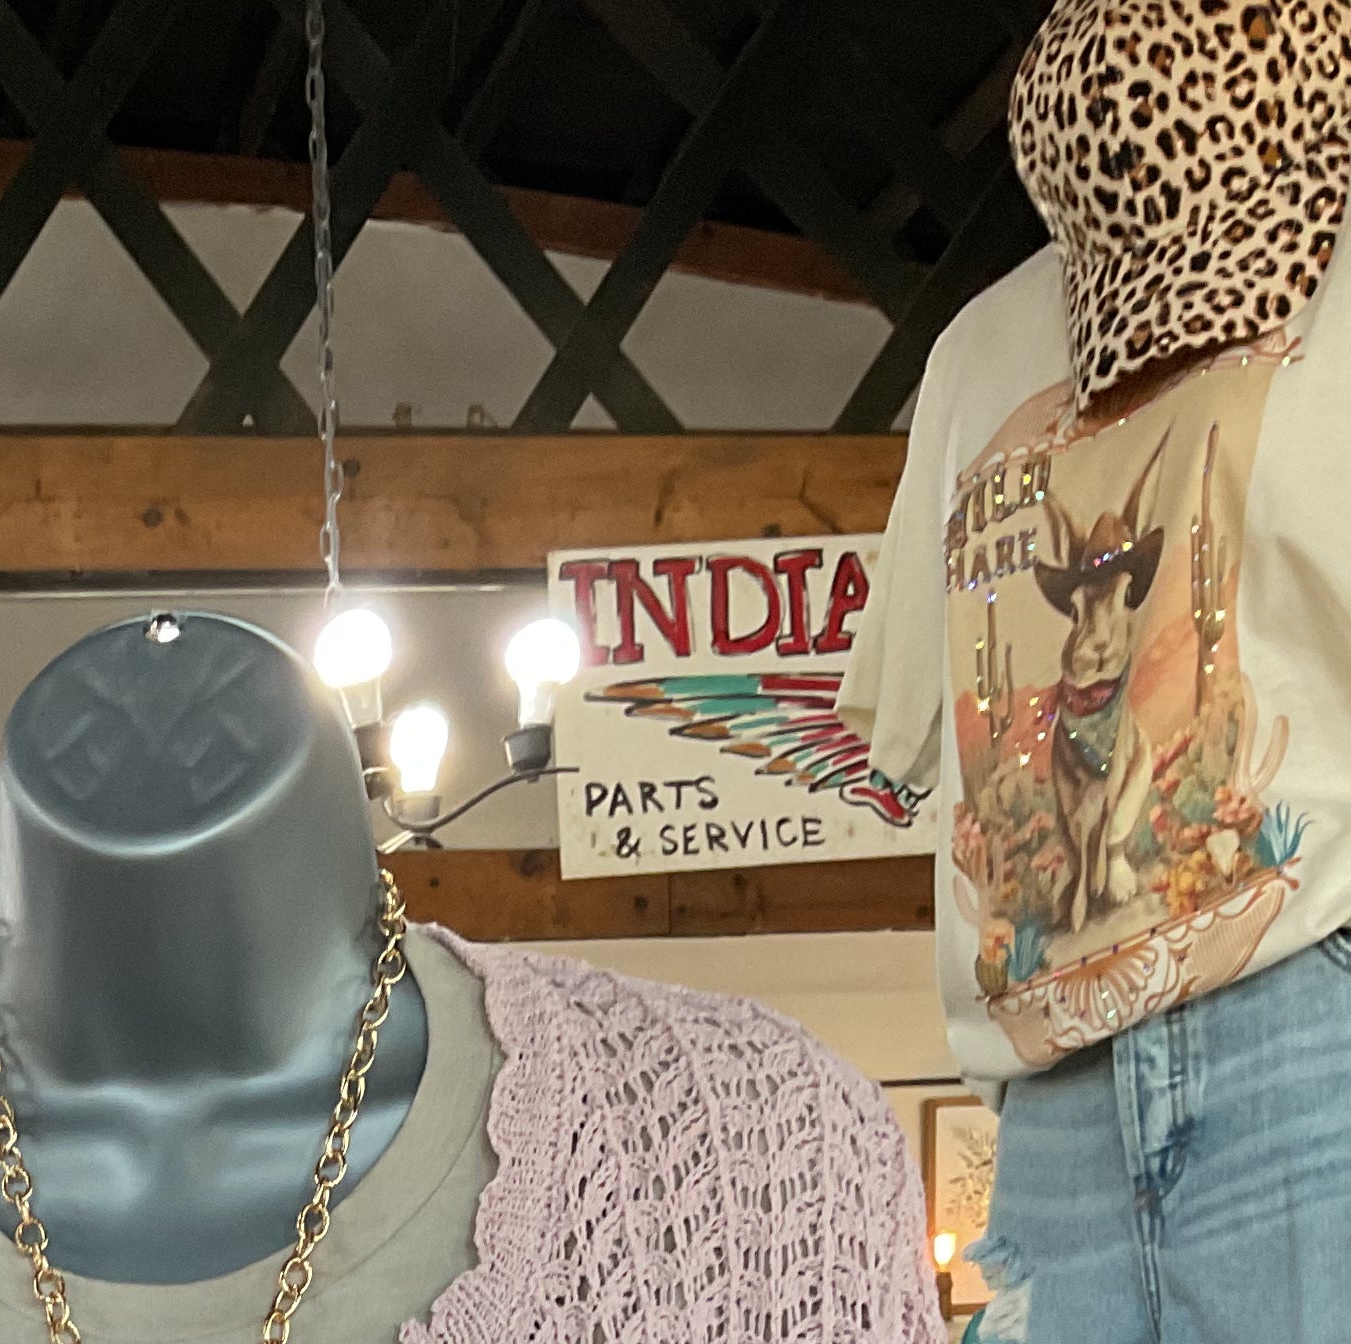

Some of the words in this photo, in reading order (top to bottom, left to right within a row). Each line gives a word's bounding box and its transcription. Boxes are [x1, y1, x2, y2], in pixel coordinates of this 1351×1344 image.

[585, 776, 719, 817] PARTS
[616, 827, 641, 858] &
[660, 816, 825, 856] SERVICE
